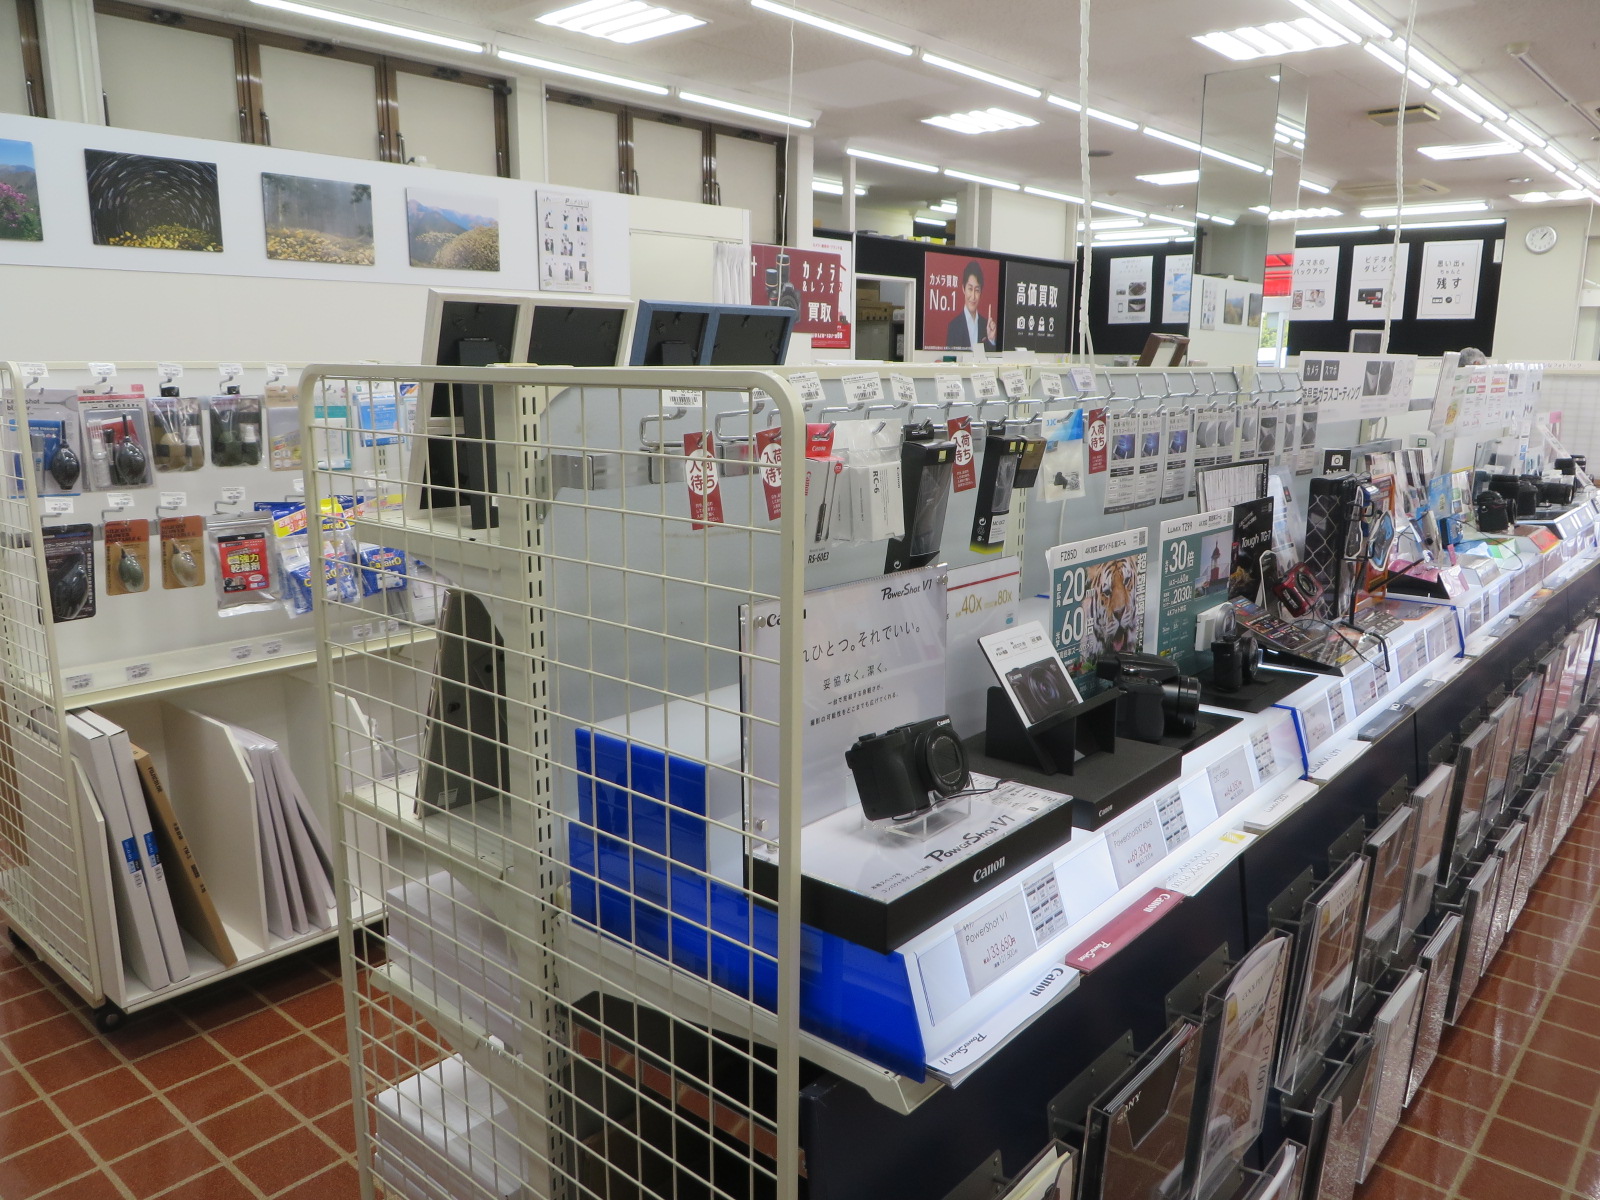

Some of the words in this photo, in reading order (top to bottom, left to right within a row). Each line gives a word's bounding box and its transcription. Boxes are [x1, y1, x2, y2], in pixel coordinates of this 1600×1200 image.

[1299, 258, 1325, 266] スマホの
[802, 260, 836, 281] カメラ
[802, 281, 834, 293] &レンズ
[929, 273, 959, 288] カメラ買取
[1436, 277, 1463, 290] 残す
[929, 288, 957, 312] No.1
[1016, 281, 1059, 308] 高価買取
[808, 301, 832, 323] 買取
[1306, 365, 1320, 376] カメラ
[1325, 365, 1337, 376] スマホ
[1091, 424, 1105, 436] 入荷
[953, 434, 970, 449] 入荷
[1090, 438, 1105, 449] 待ち
[766, 468, 781, 484] 待
[872, 470, 880, 494] RC-6
[1241, 532, 1260, 548] Tough
[807, 552, 829, 564] RS-60E3
[1060, 549, 1078, 562] FZ85D
[881, 583, 920, 601] PowerShot
[922, 578, 933, 591] V1
[936, 718, 950, 726] Canon
[1098, 804, 1113, 817] Canon
[923, 824, 998, 863] PowerShot
[995, 814, 1016, 827] V1
[972, 856, 1006, 882] Canon
[1143, 893, 1171, 913] Canon
[965, 918, 999, 946] PowerShot
[1000, 911, 1008, 922] V1
[1077, 940, 1111, 962] PowerShot
[1029, 967, 1064, 997] Canon
[948, 1032, 987, 1063] PowerShot
[938, 1052, 951, 1066] V1
[1117, 1090, 1142, 1125] SONY
